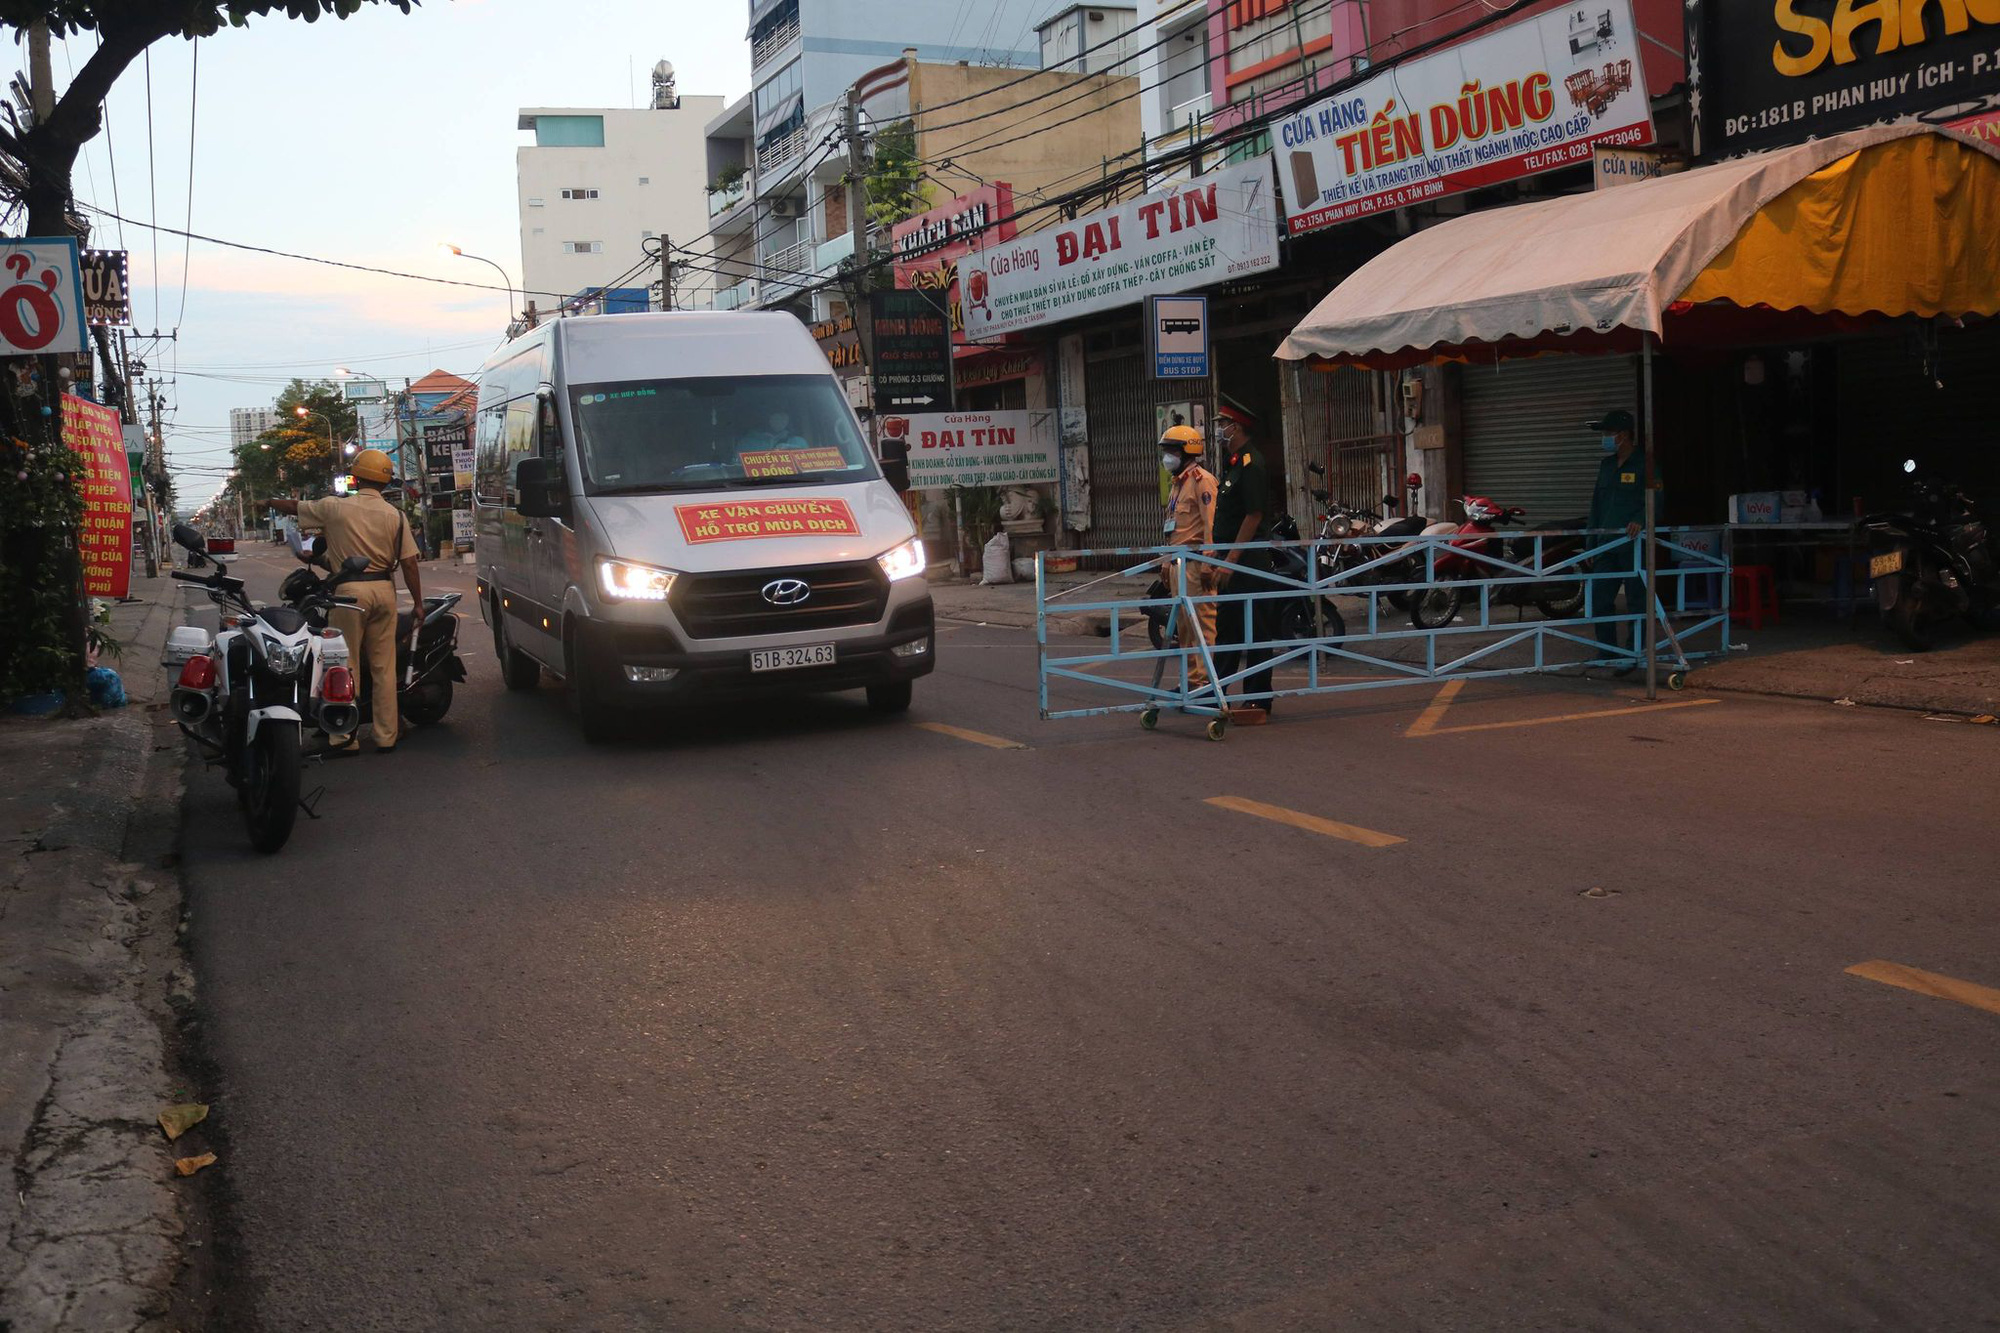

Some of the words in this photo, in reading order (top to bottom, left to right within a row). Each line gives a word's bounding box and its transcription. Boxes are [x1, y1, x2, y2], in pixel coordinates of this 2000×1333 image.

[1812, 84, 1865, 115] PHAN
[1870, 73, 1911, 101] HUY
[1917, 63, 1953, 90] ÍCH
[1318, 97, 1366, 136] HÀNG
[1336, 98, 1423, 178] TIẾN
[1430, 72, 1555, 151] DŨNG
[1322, 175, 1349, 205] THIẾT
[1348, 167, 1363, 197] KẾ
[1362, 169, 1377, 192] VÀ
[1376, 163, 1408, 190] TRANG
[1407, 156, 1427, 182] TRÍ
[1426, 153, 1445, 179] NỘI
[1445, 145, 1474, 172] THẤT
[1474, 137, 1511, 166] NGÀNH
[1513, 131, 1540, 156] MỘC
[1540, 124, 1566, 148] CAO
[1565, 110, 1592, 142] CẤP
[1523, 149, 1567, 171] TEL/FAX:
[1569, 142, 1588, 160] 028
[1603, 153, 1626, 174] CỬA
[1307, 212, 1324, 226] 175A
[1325, 206, 1345, 222] PHAN
[1345, 202, 1359, 216] HUY
[1406, 183, 1423, 200] TÂN
[1424, 178, 1444, 197] BÌNH
[990, 253, 1010, 277] Cửa
[1011, 245, 1040, 272] Hàng
[1056, 214, 1122, 267] ĐẠI
[1138, 182, 1218, 240] TÍN
[81, 254, 123, 302] ỬA
[1019, 289, 1033, 302] MUA
[1107, 261, 1130, 281] DỰNG
[1152, 248, 1178, 266] COFFA
[1000, 306, 1014, 321] CHO
[1097, 282, 1121, 300] COFFA
[1122, 273, 1144, 290] THÉP
[1149, 266, 1166, 284] CÂY
[1168, 258, 1196, 278] CHỐNG
[86, 303, 123, 319] ƯỜNG
[1163, 366, 1180, 375] BUS
[1181, 366, 1201, 375] STOP
[944, 414, 963, 424] Cửa
[965, 413, 992, 424] Hàng
[921, 430, 966, 451] ĐẠI
[970, 425, 1016, 447] TÍN
[743, 453, 779, 465] CHUYẾN
[779, 454, 791, 463] XE
[761, 464, 794, 477] ĐỒNG
[88, 484, 117, 496] PHÉP
[103, 500, 131, 513] TRÊN
[698, 509, 721, 520] XE
[724, 505, 761, 519] VẬN
[764, 501, 833, 516] CHUYỂN
[94, 517, 125, 531] QUẬN
[695, 520, 720, 537] HỖ
[724, 520, 760, 535] TRỢ
[764, 518, 805, 532] MÙA
[807, 519, 848, 532] DỊCH
[101, 548, 123, 562] CỦA
